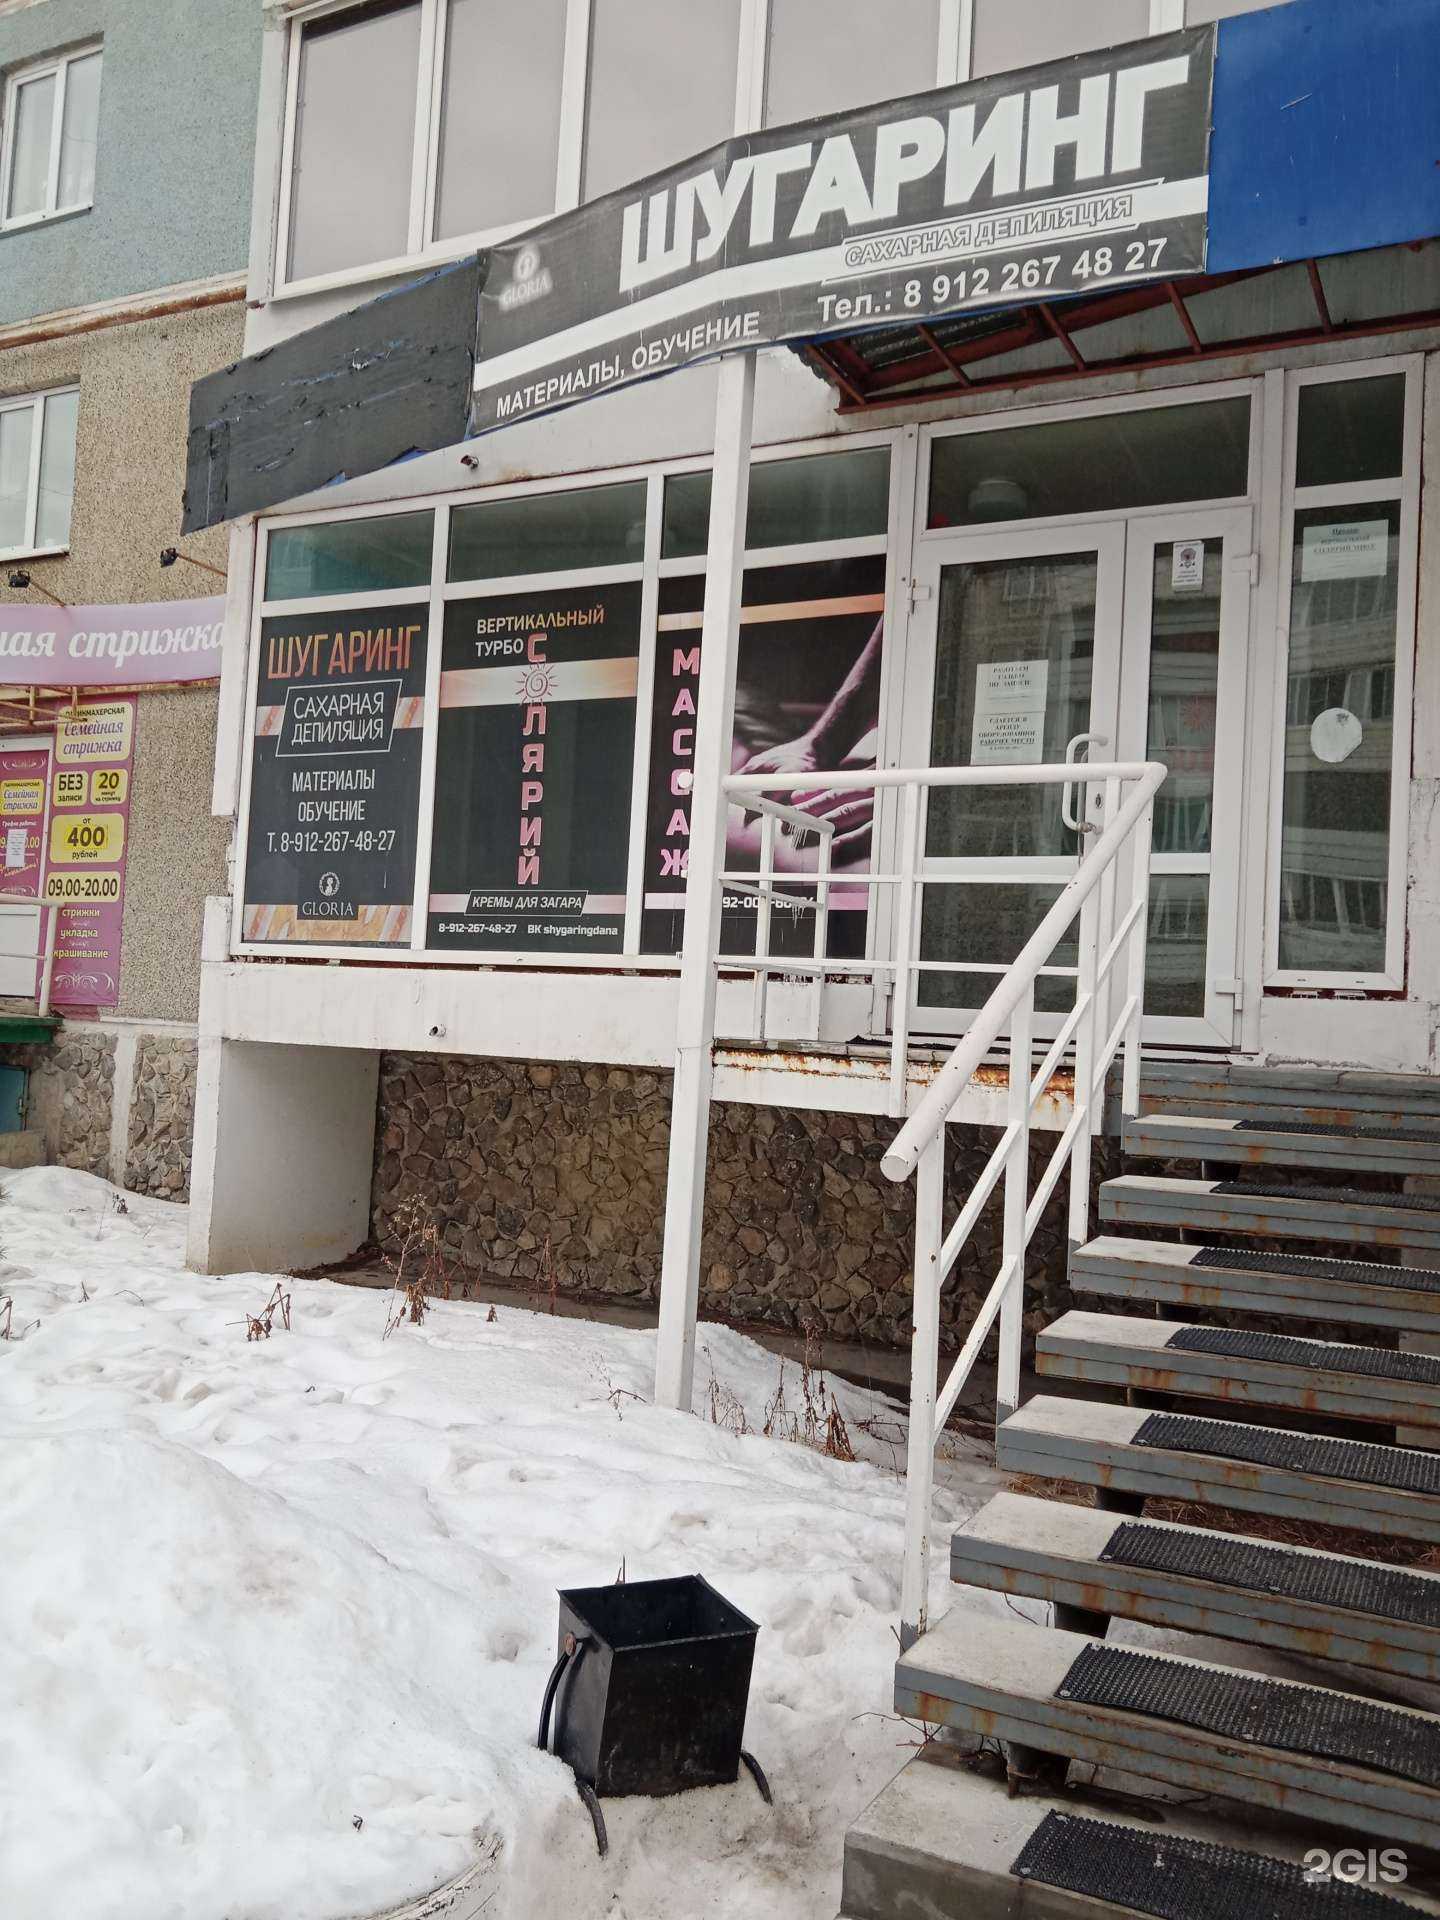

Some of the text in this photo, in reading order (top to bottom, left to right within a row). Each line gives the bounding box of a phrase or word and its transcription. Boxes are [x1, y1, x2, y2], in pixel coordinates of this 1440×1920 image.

[619, 56, 1190, 293] ШУГАРИНГ
[845, 195, 1133, 267] САХАРНАЯ ДЕПИЛЯЦИЯ
[818, 237, 1168, 323] Тел.: 8 912 267 48 27
[496, 311, 760, 419] МАТЕРИАЛЫ, ОБУЧЕНИЕ
[476, 604, 605, 635] ВЕРТИКАЛЬНЫЙ
[69, 622, 225, 668] стрижка
[267, 625, 421, 681] ШУГАРИНГ
[475, 639, 524, 658] ТУРБО
[293, 691, 385, 720] САХАРНАЯ
[291, 718, 384, 746] ДЕПИЛЯЦИЯ
[63, 740, 122, 758] стрижка
[58, 773, 83, 791] БЕЗ
[98, 772, 120, 789] 20
[292, 769, 376, 793] МАТЕРИАЛЫ
[298, 801, 366, 823] ОБУЧЕНИЕ
[67, 826, 105, 847] 400
[280, 829, 396, 853] 8-912-267-48-27
[72, 850, 98, 859] рублей
[48, 878, 118, 897] 09.00-20.00
[302, 901, 354, 917] GLORIA
[472, 896, 582, 910] КРЕМЫ ДЛЯ ЗАГАРА
[62, 909, 100, 919] стрижки
[438, 923, 517, 934] 8-912-267-48-27
[52, 949, 109, 959] крашивание
